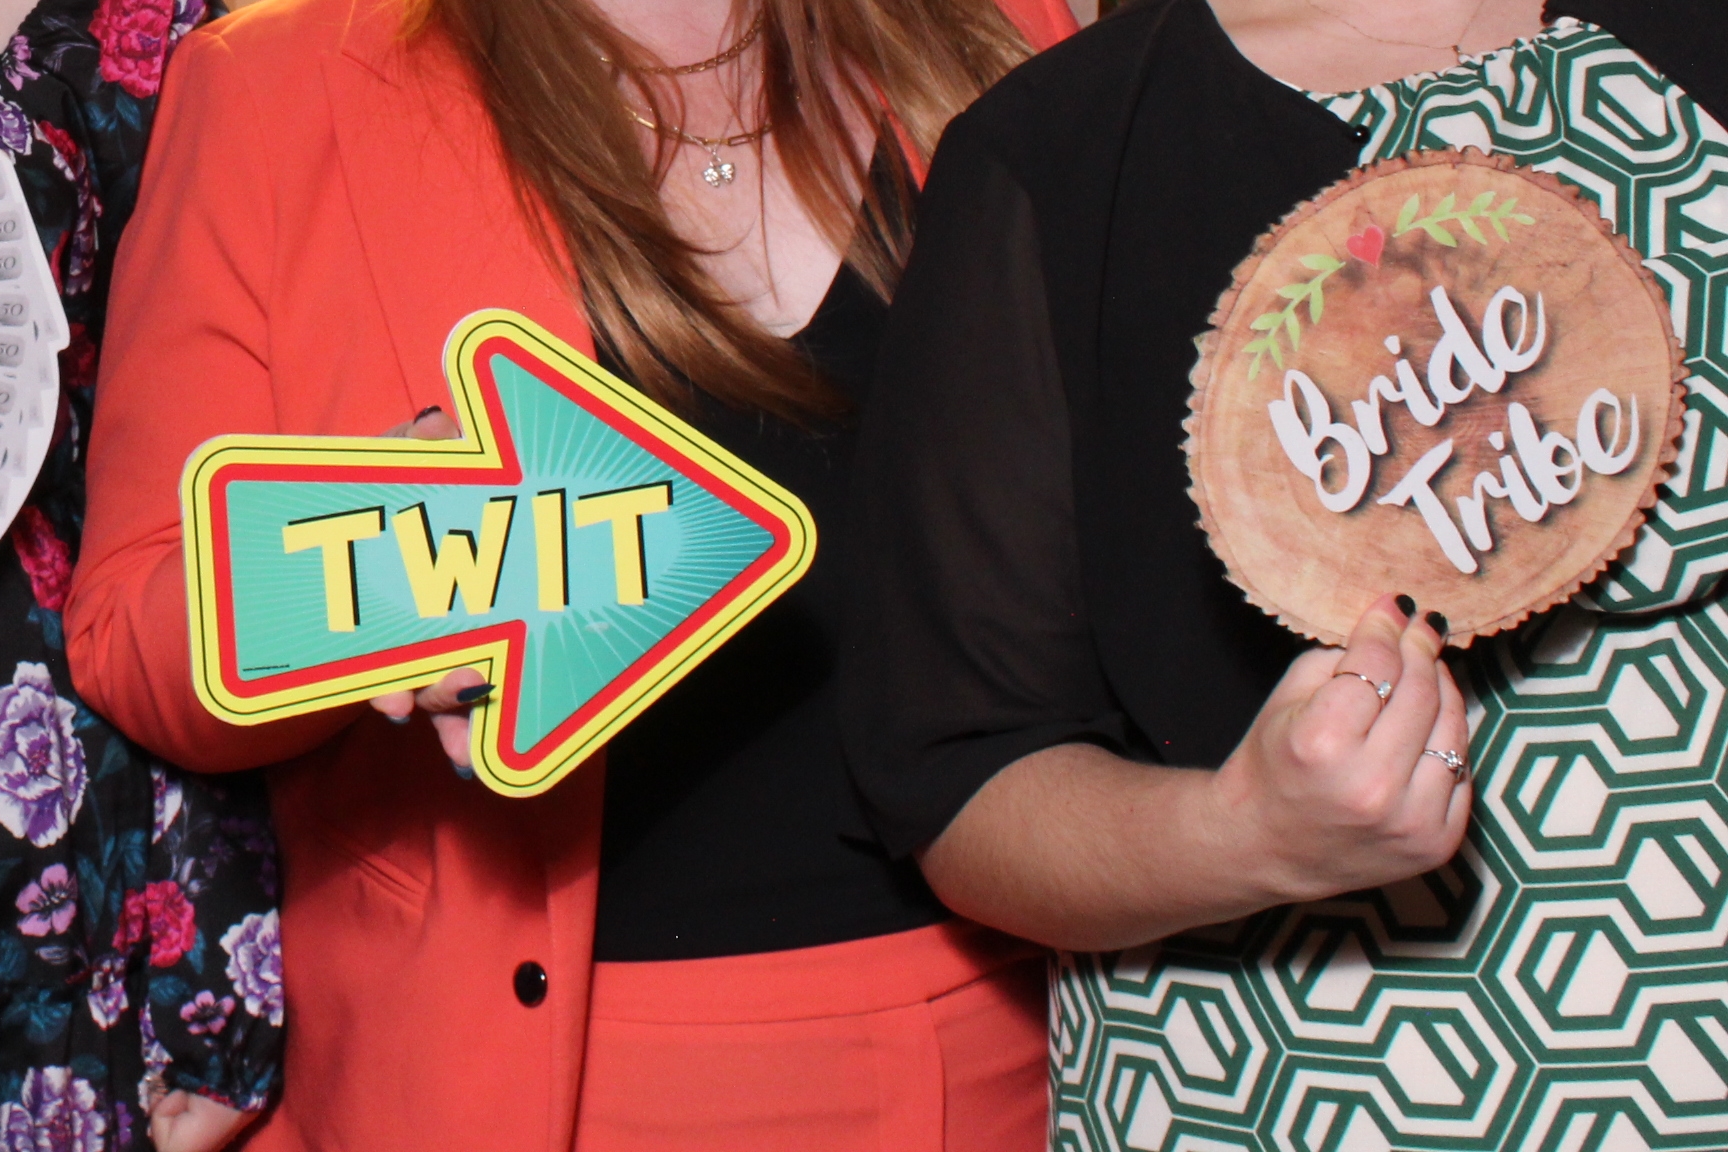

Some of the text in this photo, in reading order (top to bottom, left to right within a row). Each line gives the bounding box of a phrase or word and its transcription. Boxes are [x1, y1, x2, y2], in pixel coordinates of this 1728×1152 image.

[1268, 285, 1547, 513] Bride
[1377, 388, 1640, 575] Tribe
[282, 481, 672, 633] TWIT
